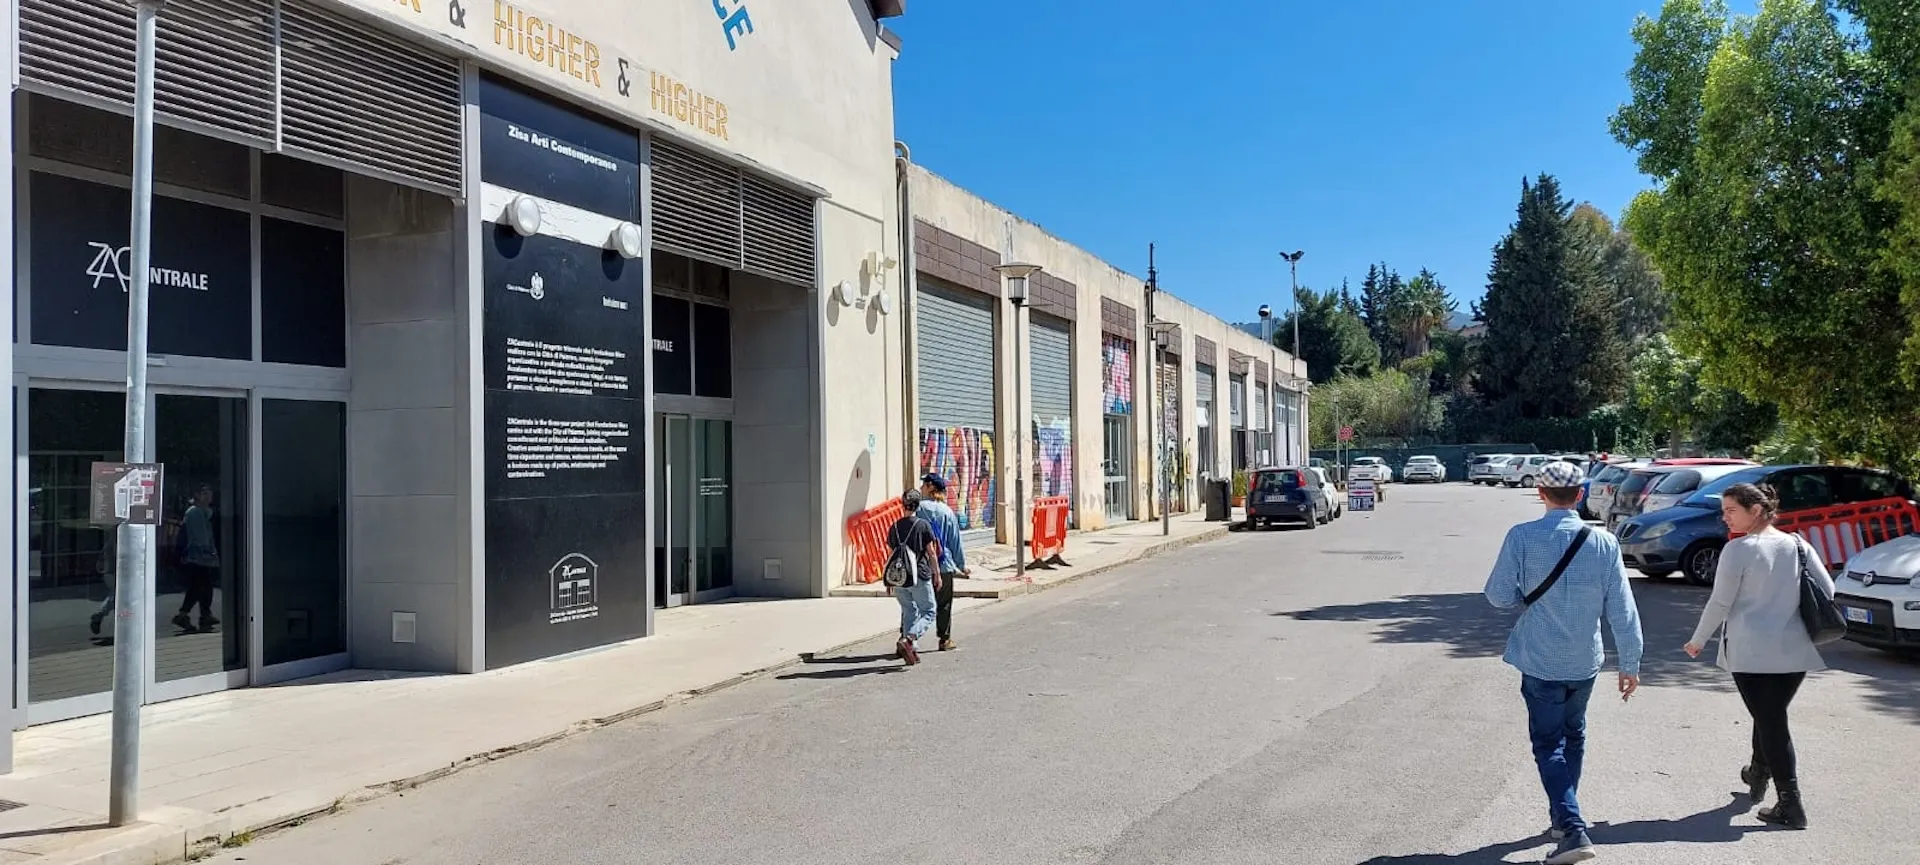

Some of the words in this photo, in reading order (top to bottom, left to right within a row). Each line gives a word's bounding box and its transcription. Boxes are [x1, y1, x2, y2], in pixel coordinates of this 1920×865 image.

[493, 0, 601, 88] HIGHER
[617, 57, 631, 97] &
[651, 71, 729, 141] HIGHER
[508, 124, 529, 142] Zisa
[531, 132, 549, 149] Arti
[653, 338, 673, 352] TRALE
